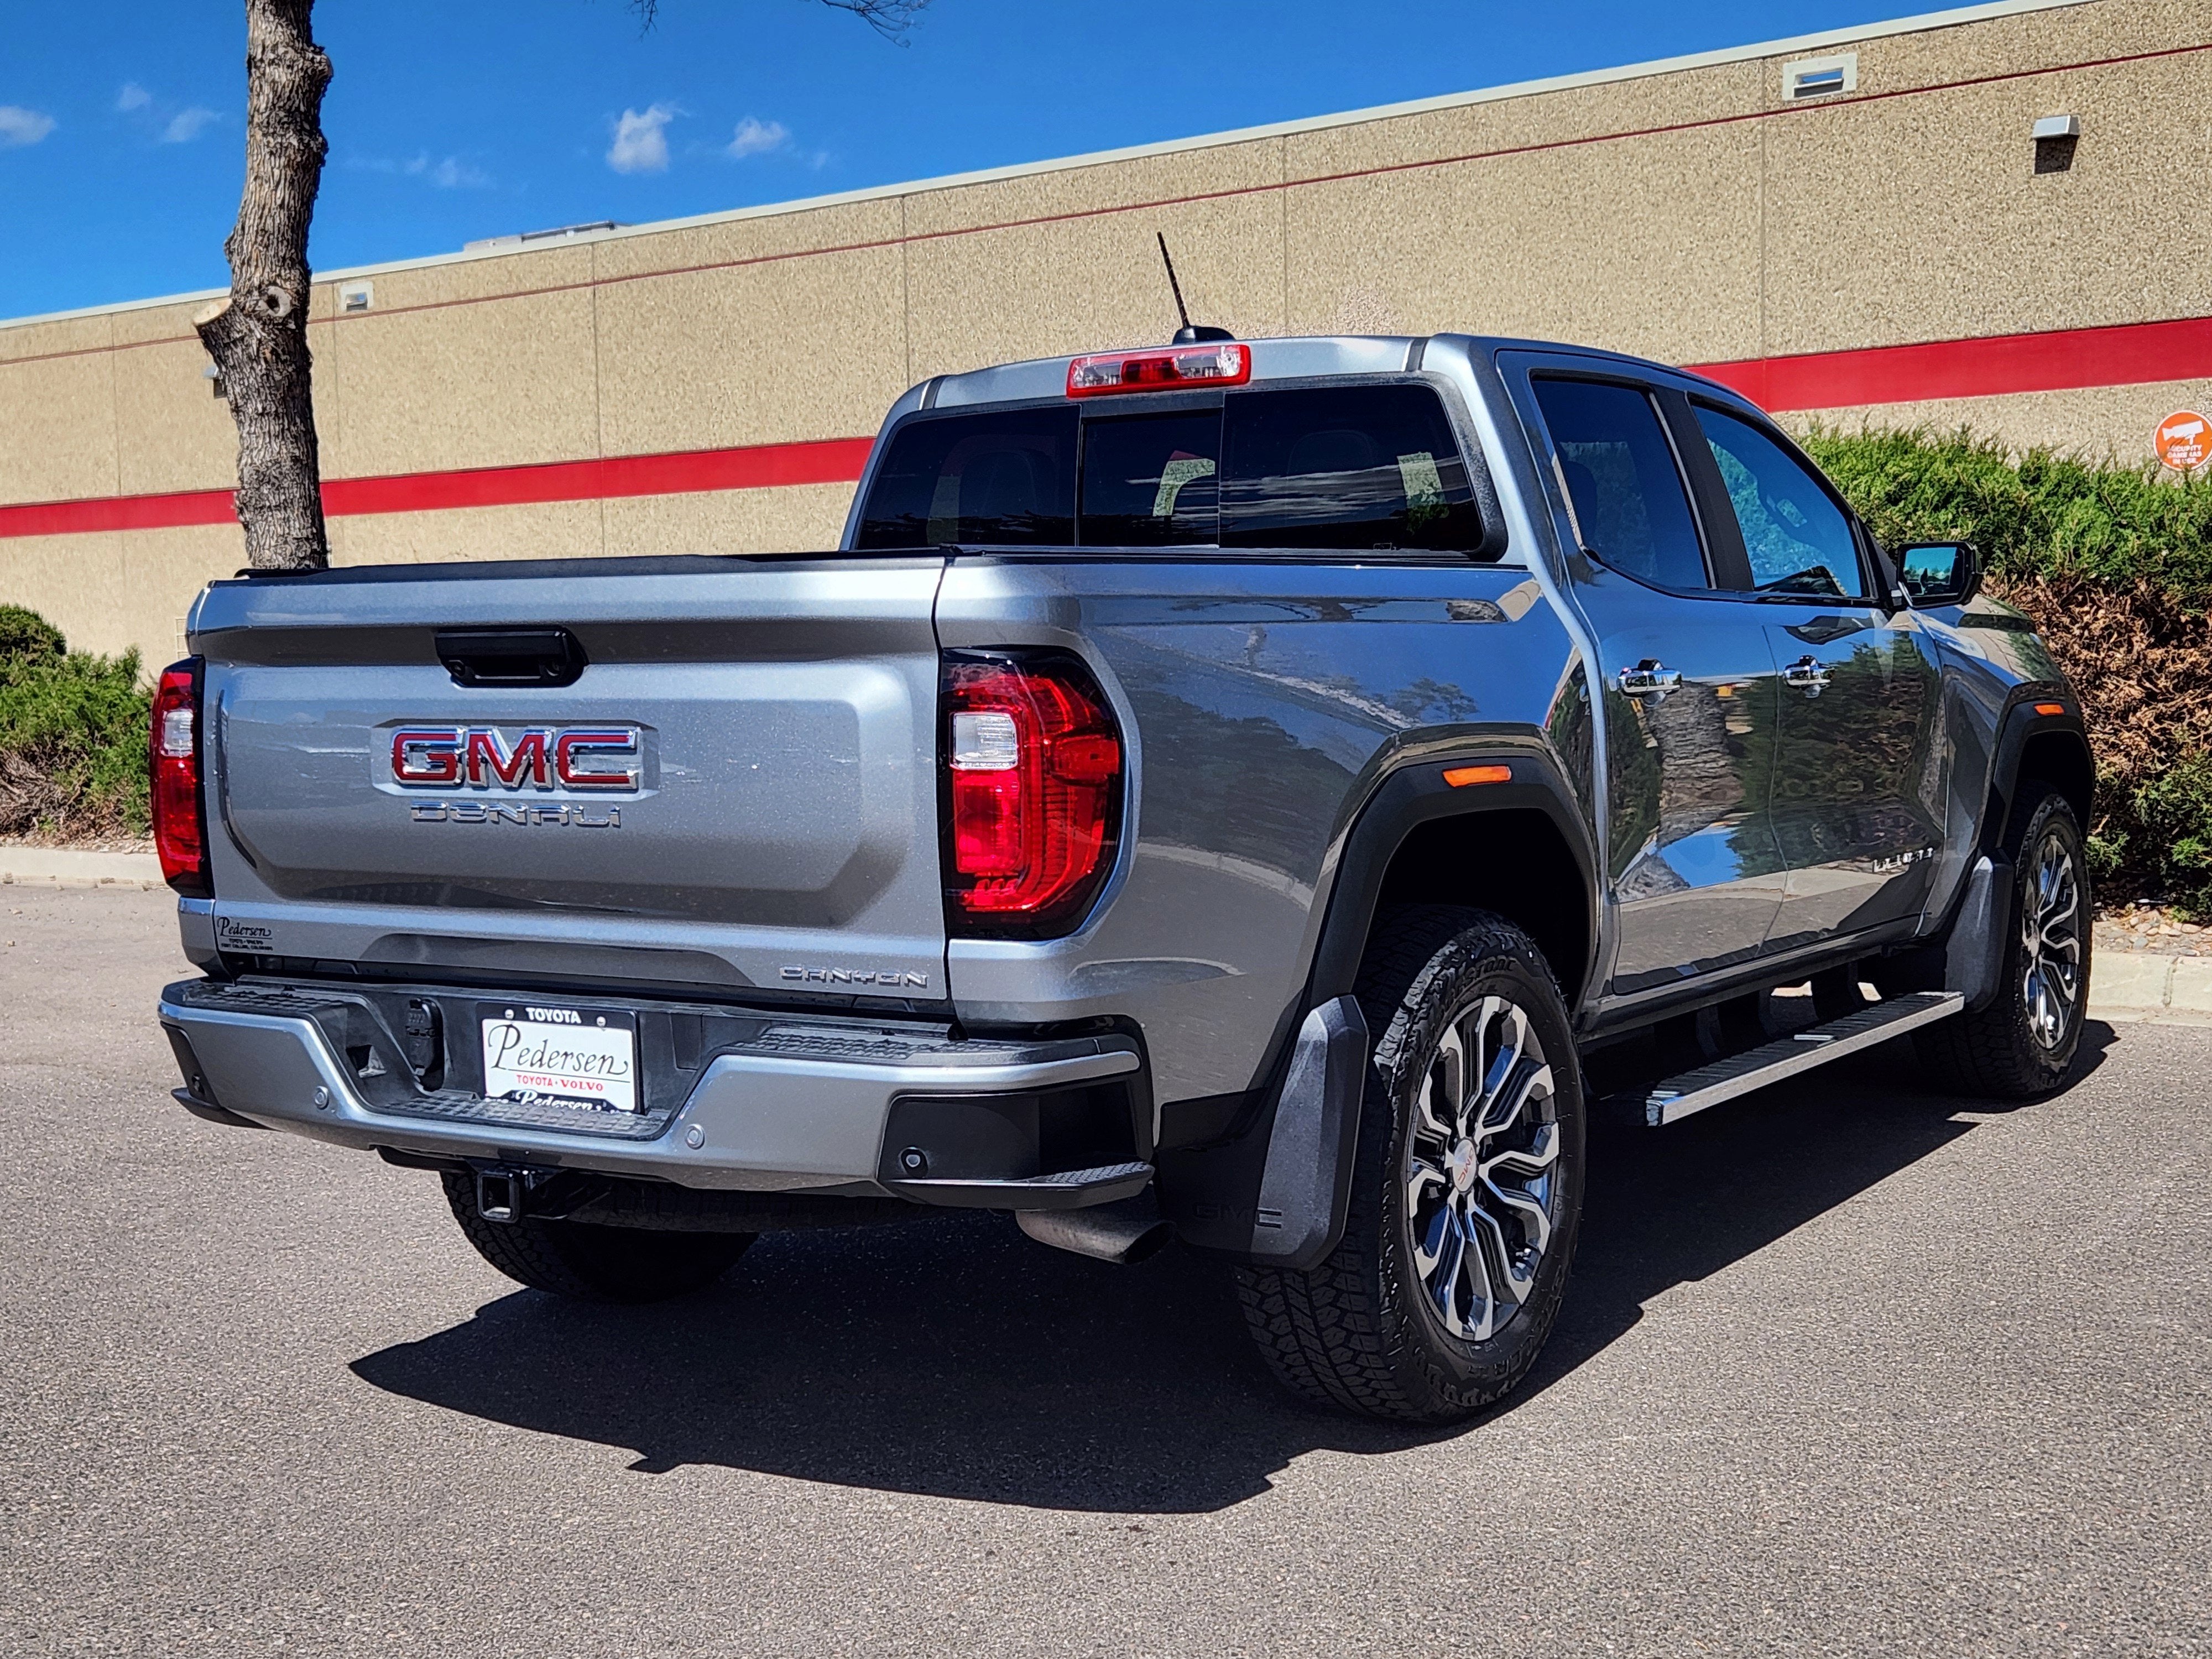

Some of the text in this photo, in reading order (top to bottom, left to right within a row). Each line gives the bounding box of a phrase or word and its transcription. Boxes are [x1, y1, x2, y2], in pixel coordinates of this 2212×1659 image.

[392, 727, 640, 792] GMC
[411, 800, 622, 828] DENALI
[217, 916, 272, 937] Pedersen
[779, 964, 929, 988] CANYON
[525, 1007, 582, 1024] TOYOTA
[488, 1024, 629, 1076] Pedersen
[517, 1074, 604, 1092] TOYOTA VOLVO
[515, 1088, 602, 1112] Pedersen
